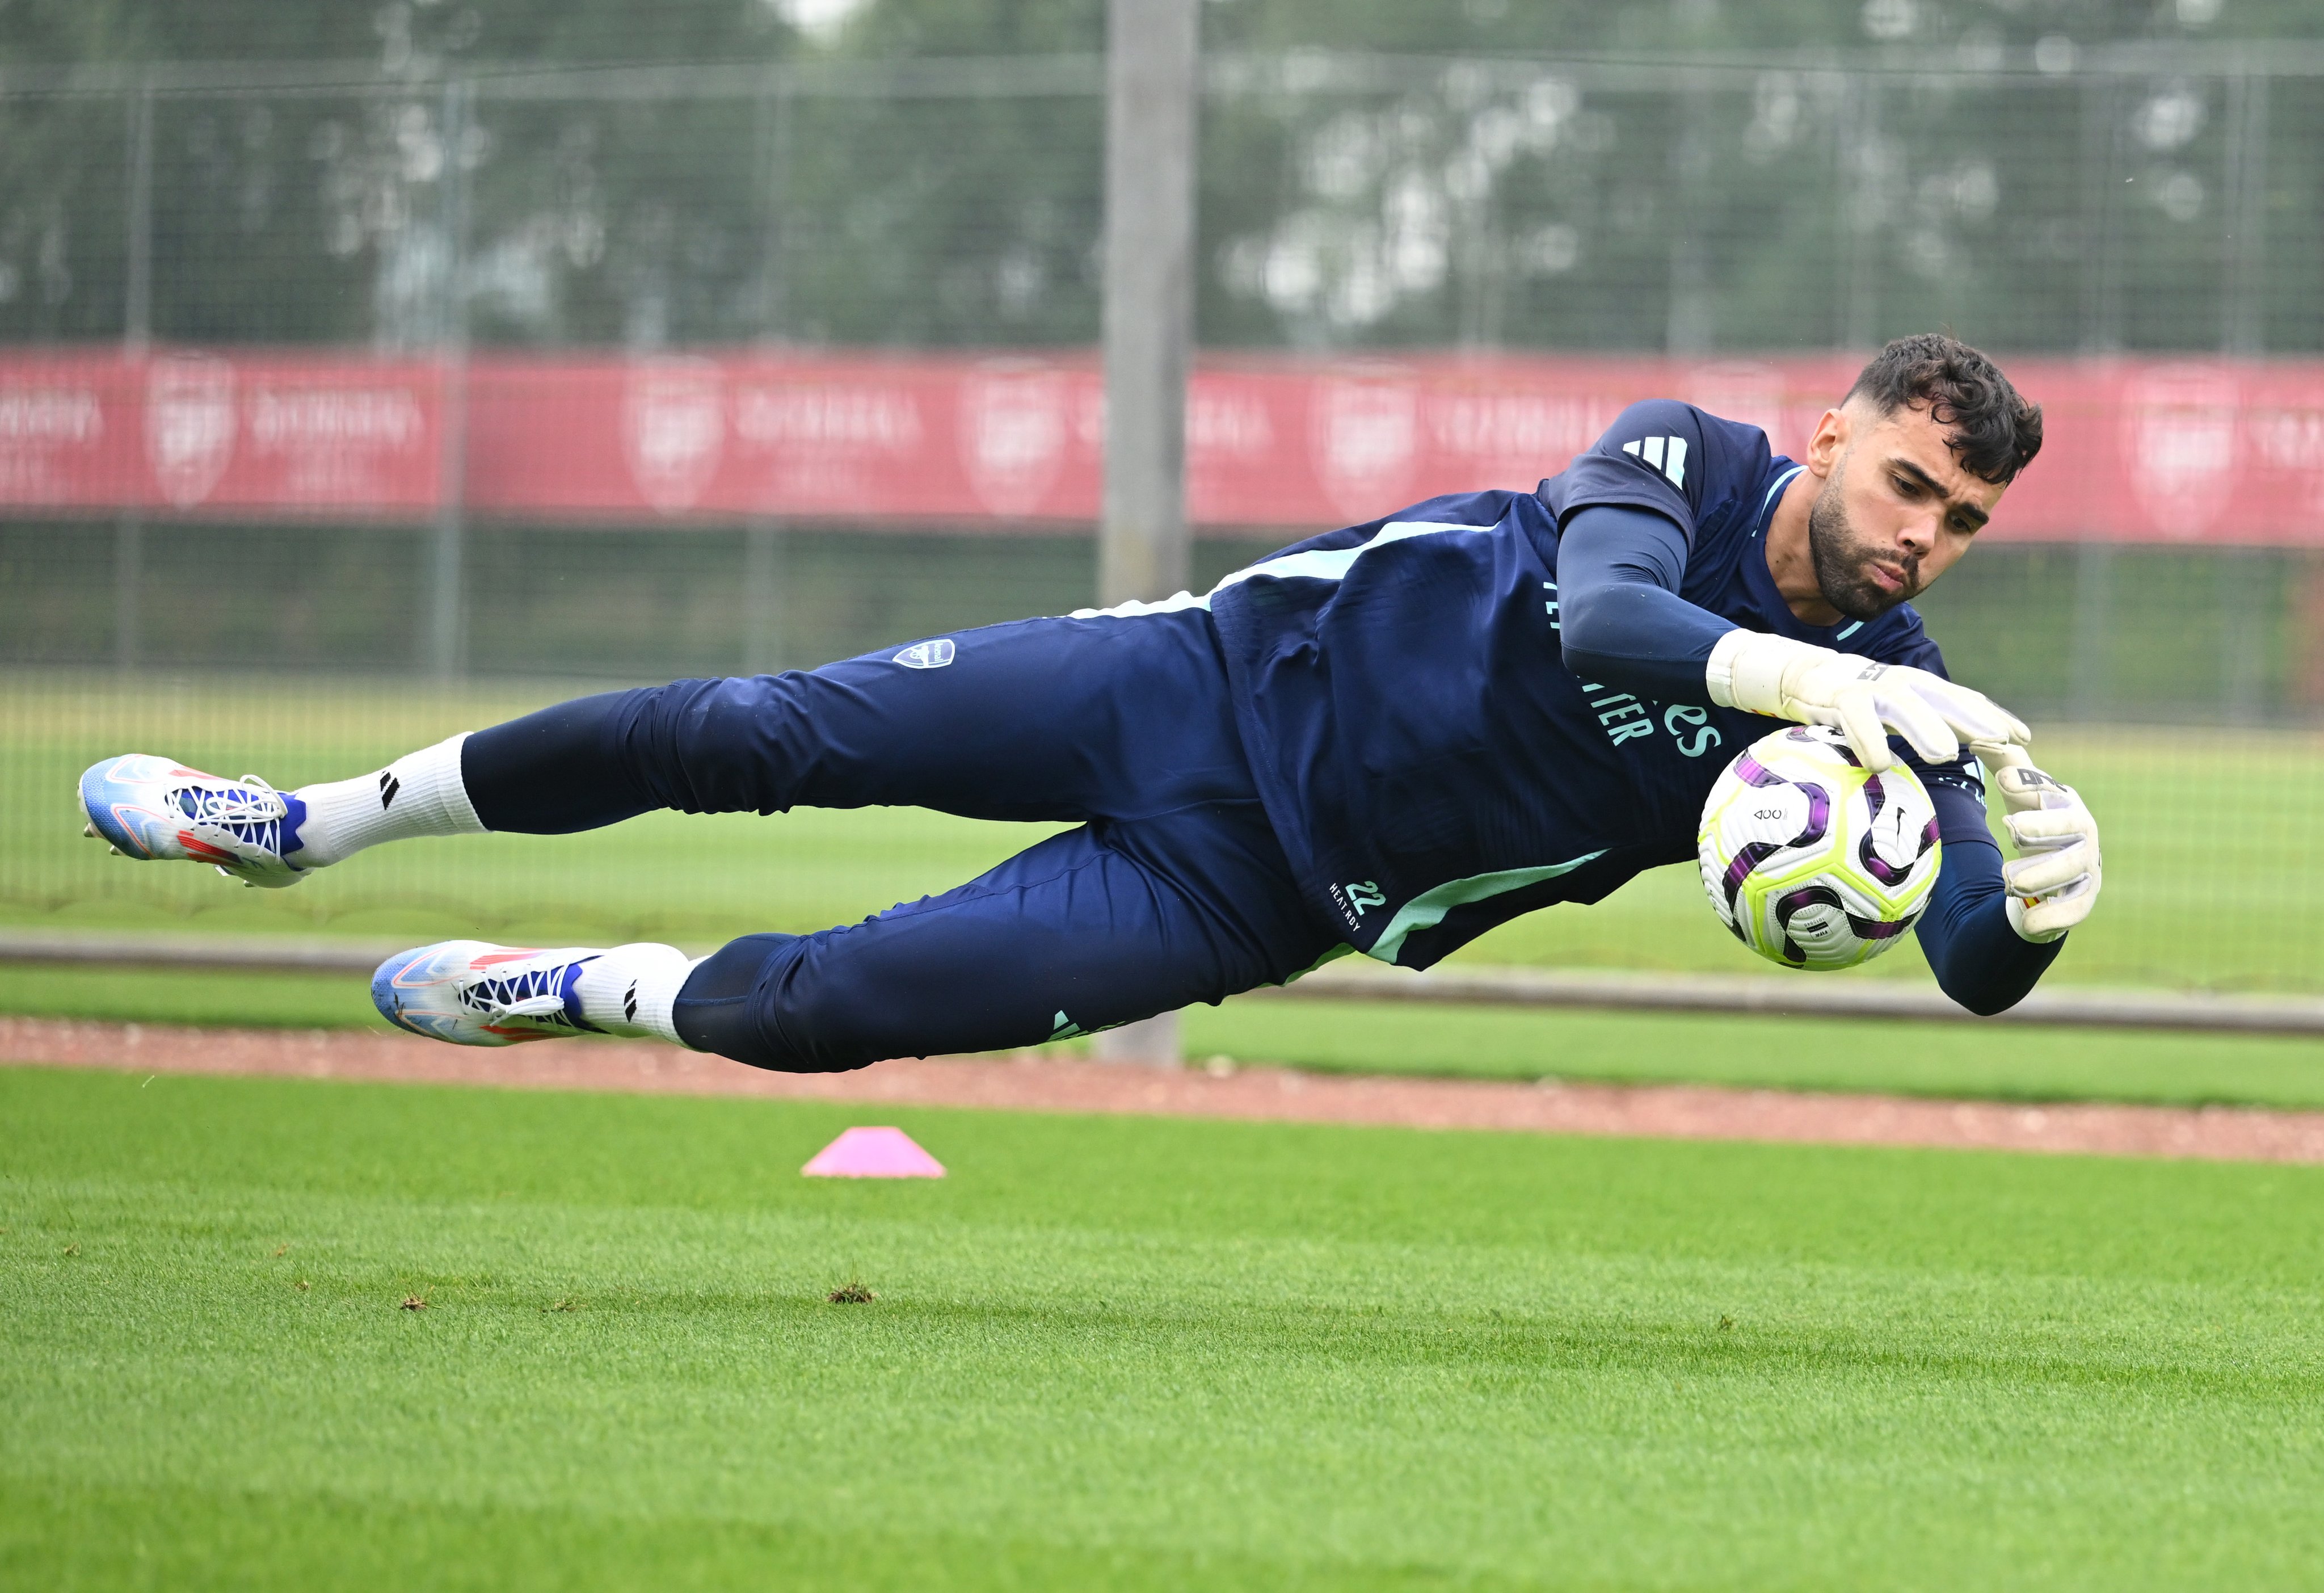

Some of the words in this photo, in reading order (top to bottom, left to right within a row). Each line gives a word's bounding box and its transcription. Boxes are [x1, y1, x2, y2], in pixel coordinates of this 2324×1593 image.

[1580, 683, 1654, 747] TER
[1329, 882, 1361, 932] HEAT.RDY
[1345, 880, 1387, 916] 22
